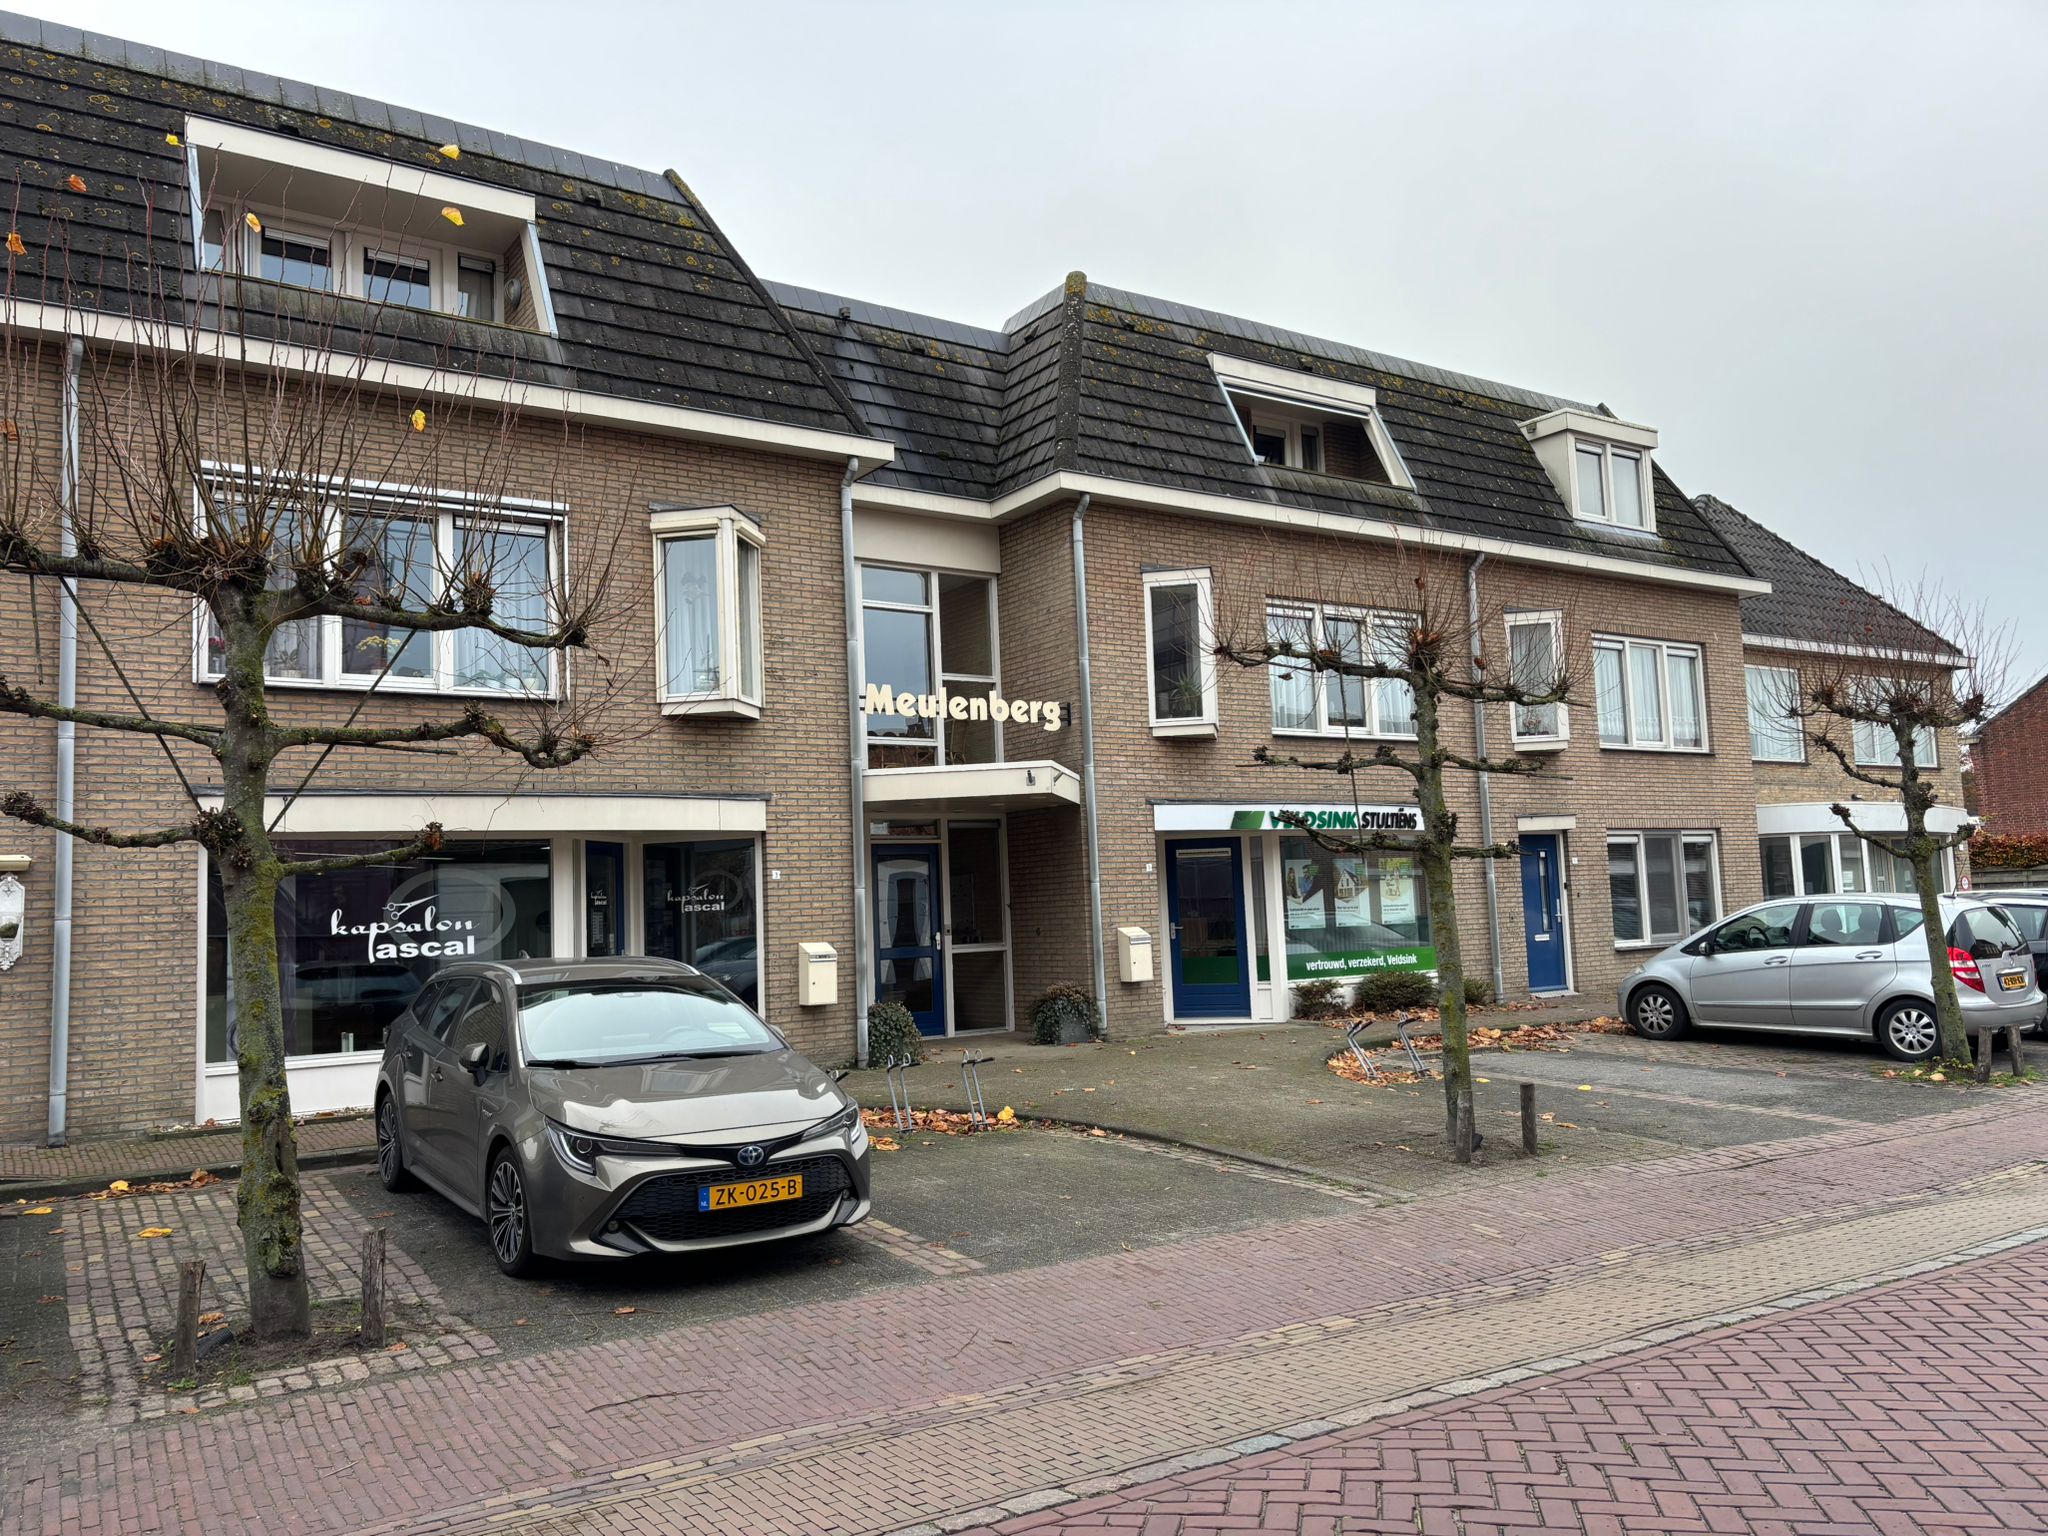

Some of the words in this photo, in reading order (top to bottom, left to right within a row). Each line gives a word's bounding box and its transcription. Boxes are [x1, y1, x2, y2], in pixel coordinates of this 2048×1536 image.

[865, 683, 1061, 732] Meulenberg
[1269, 810, 1358, 829] VDSINK
[1361, 808, 1417, 829] STULTIËNS
[667, 888, 724, 903] kapsalon
[331, 905, 477, 939] kapsalon
[1306, 958, 1347, 971] vertrouwd,
[1348, 955, 1386, 968] verzekerd,
[1387, 953, 1418, 965] Veldsink
[715, 1178, 798, 1206] ZK-025-B
